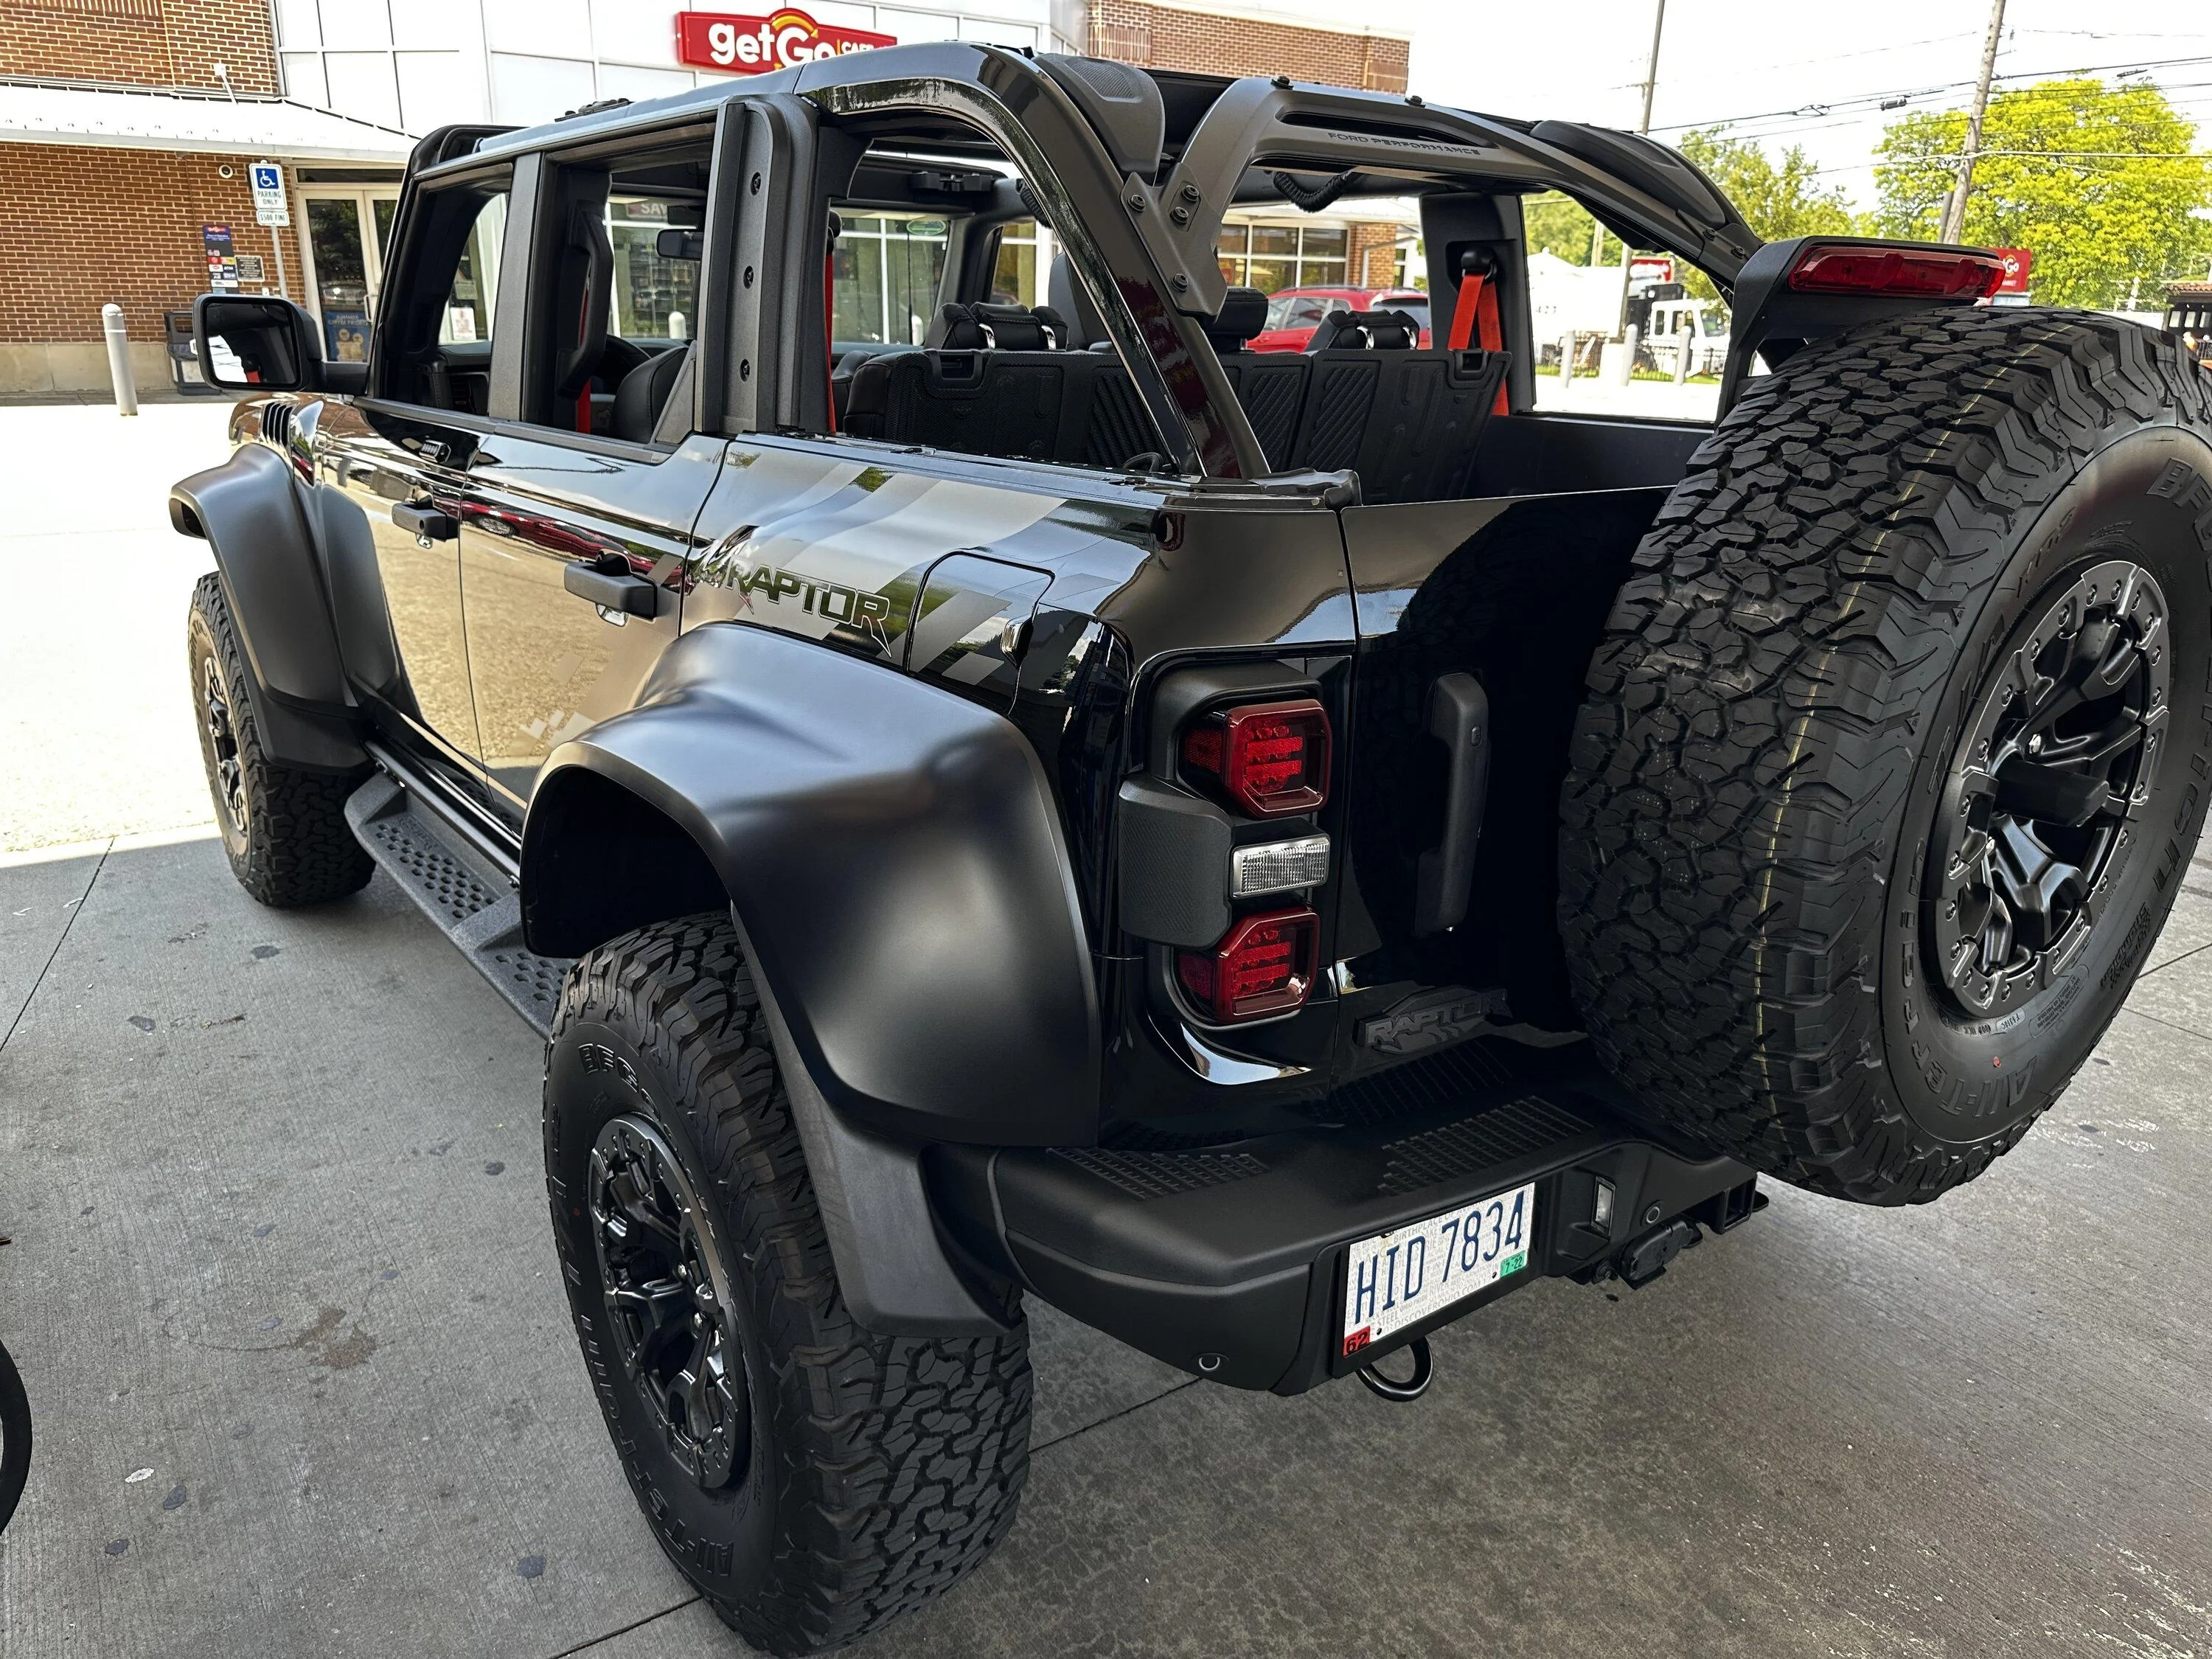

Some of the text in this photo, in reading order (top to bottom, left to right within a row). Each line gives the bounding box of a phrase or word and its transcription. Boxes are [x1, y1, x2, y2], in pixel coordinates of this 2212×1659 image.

[709, 23, 835, 67] getGo
[1328, 133, 1481, 156] FORD PERFORMANCE
[726, 554, 892, 658] RAPTOR
[1366, 987, 1514, 1050] RAPTOR
[1354, 1190, 1525, 1325] HID 7834
[1377, 1312, 1399, 1326] STEEL
[1346, 1332, 1368, 1354] 62
